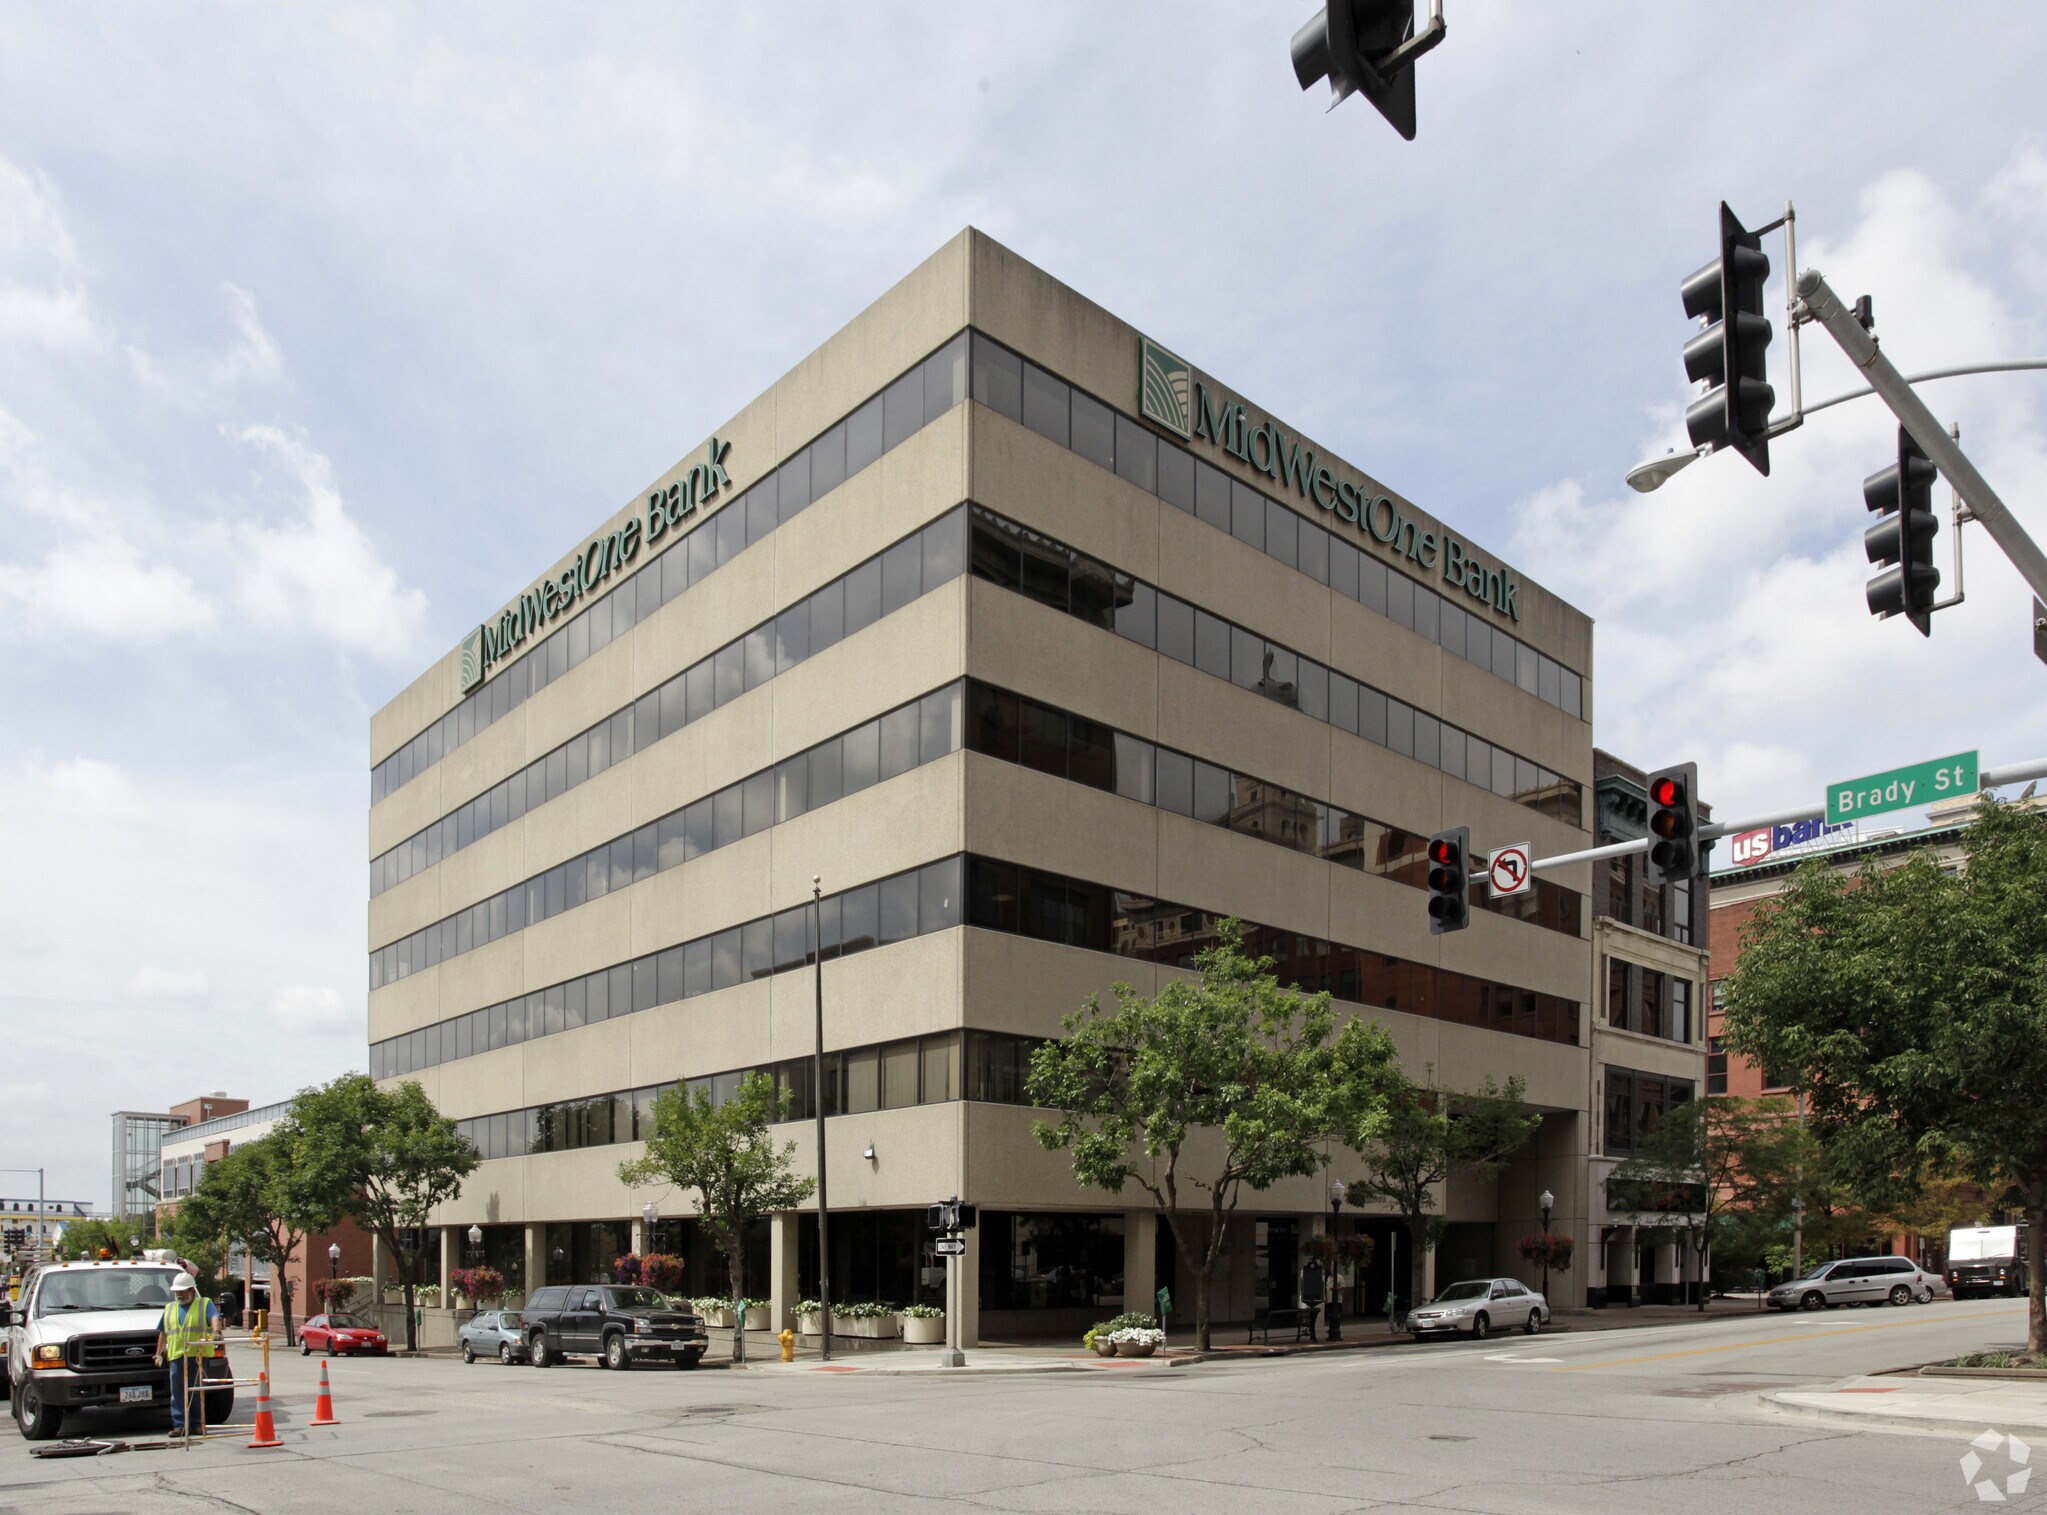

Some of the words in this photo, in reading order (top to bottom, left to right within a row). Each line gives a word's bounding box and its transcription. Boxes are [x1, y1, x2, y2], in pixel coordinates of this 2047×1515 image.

[484, 516, 642, 668] MidWestOne
[646, 437, 732, 544] Bank
[1196, 382, 1439, 568] MidWestOne
[1444, 536, 1521, 622] Bank
[1733, 832, 1769, 863] us
[1839, 780, 1916, 813] Brady
[1934, 765, 1964, 791] St
